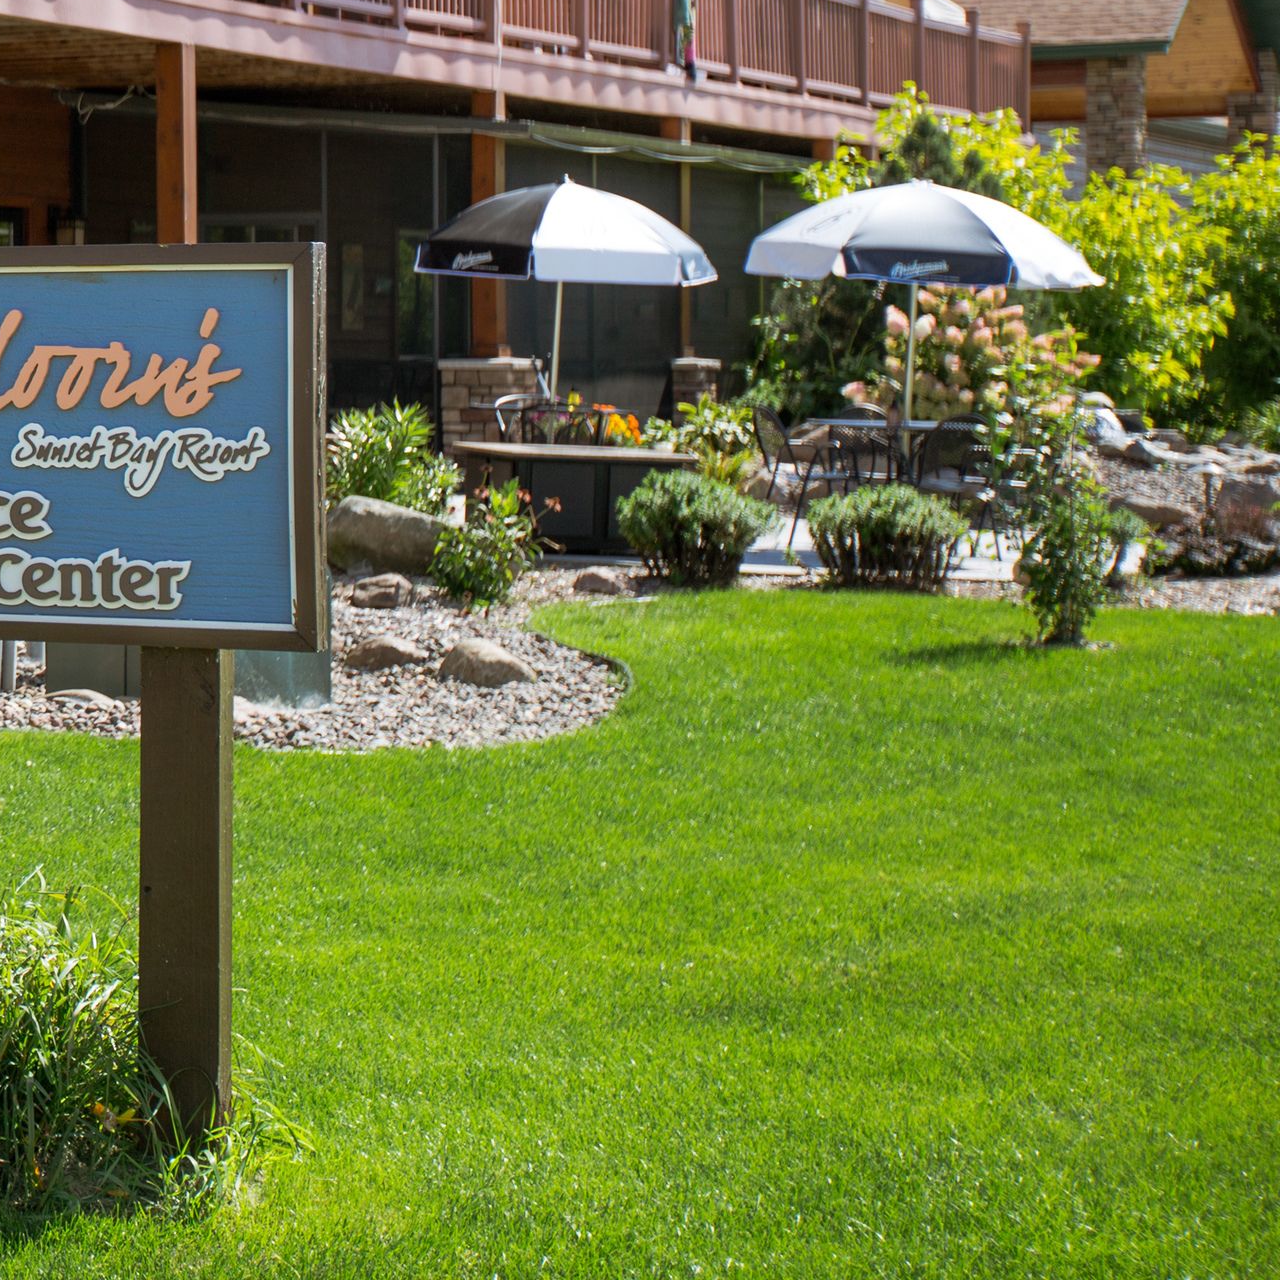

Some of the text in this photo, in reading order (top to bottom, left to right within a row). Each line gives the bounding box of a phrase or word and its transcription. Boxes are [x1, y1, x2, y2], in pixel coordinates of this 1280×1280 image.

[14, 427, 264, 492] Sunset Bay Resort
